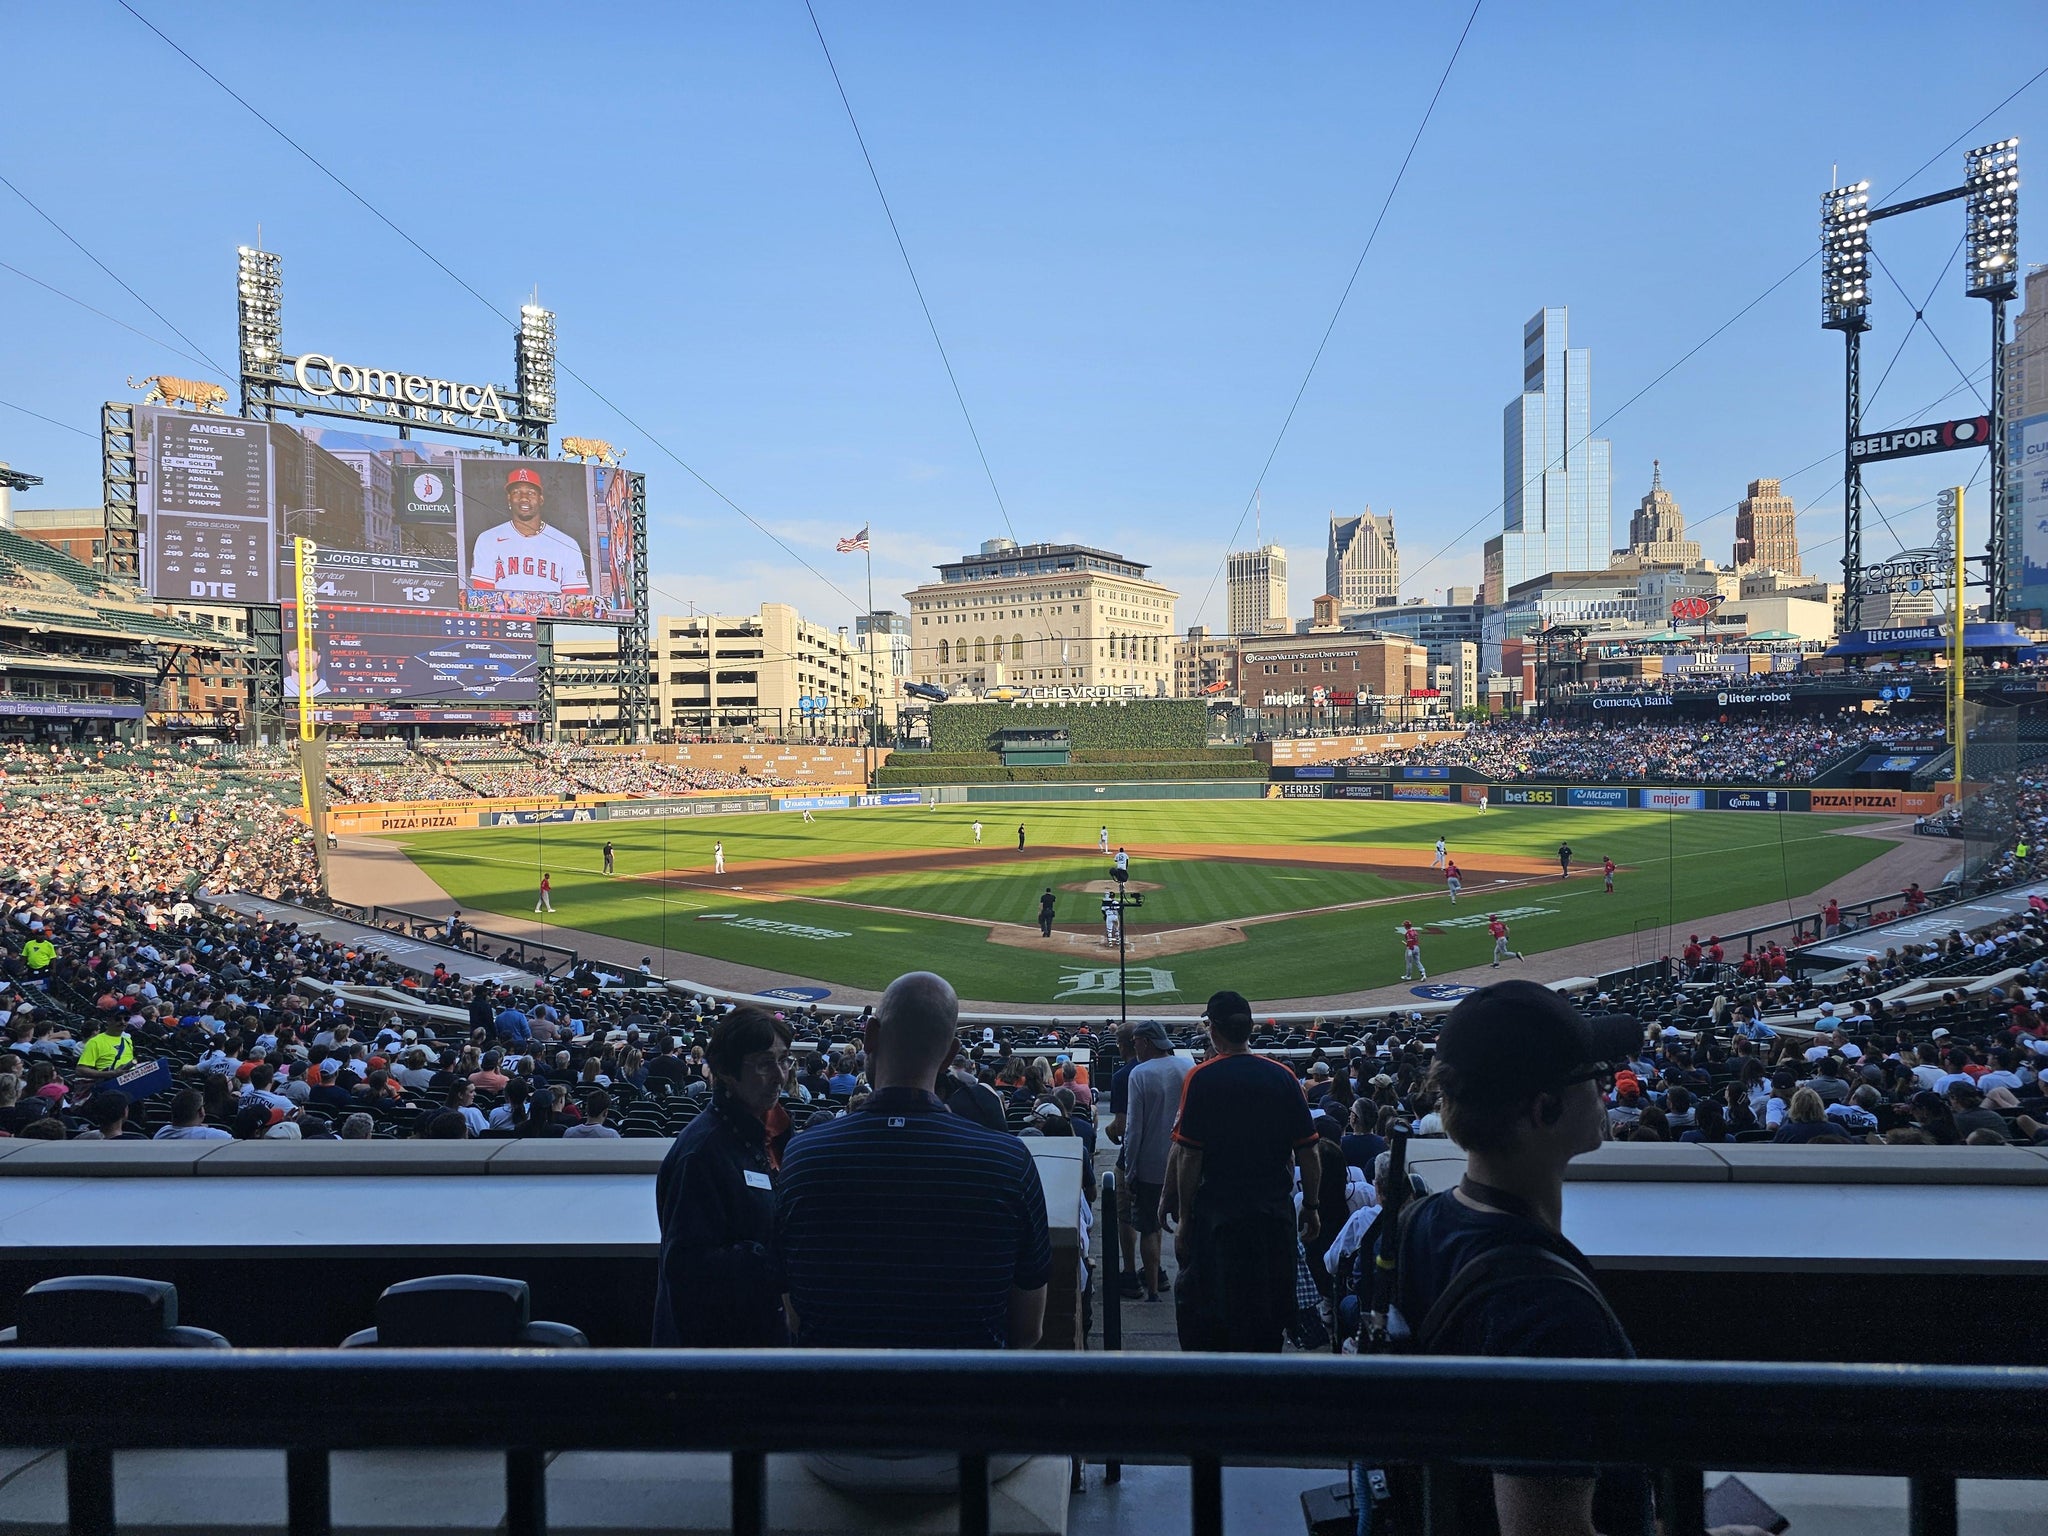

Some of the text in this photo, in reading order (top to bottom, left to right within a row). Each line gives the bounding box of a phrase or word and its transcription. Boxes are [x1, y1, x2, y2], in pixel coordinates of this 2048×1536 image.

[358, 398, 456, 425] PARK
[190, 423, 245, 437] ANGELS
[188, 445, 215, 453] TROUT
[1852, 429, 1938, 457] BELFOR
[188, 483, 219, 491] PERAZA
[188, 491, 221, 499] WALTON
[324, 554, 419, 569] JORGE SOLER
[495, 556, 563, 583] ANGEL
[302, 555, 319, 611] Rocket
[392, 577, 445, 587] LAUNCH ANGLE
[190, 581, 236, 598] DTE
[337, 590, 359, 598] MPH
[506, 622, 531, 631] 3-2
[1867, 629, 1935, 643] Lite LOUNGE
[1695, 652, 1718, 666] Lite
[1032, 685, 1144, 698] CHEVROLET
[1011, 700, 1127, 708] FOUNTAIN
[1264, 691, 1306, 707] meijer
[1422, 697, 1440, 705] LAW
[1645, 696, 1673, 706] Bank
[18, 704, 43, 713] Efficiency
[1284, 785, 1320, 793] FERRIS
[860, 796, 881, 805] DTE
[1505, 790, 1552, 803] bet365
[1587, 791, 1621, 800] McLaren
[1653, 793, 1690, 807] meijer
[1813, 796, 1896, 807] PIZZA! PIZZA!
[660, 805, 689, 815] BETMGM
[382, 816, 457, 829] PIZZA! PIZZA!
[736, 917, 853, 938] VICTORS
